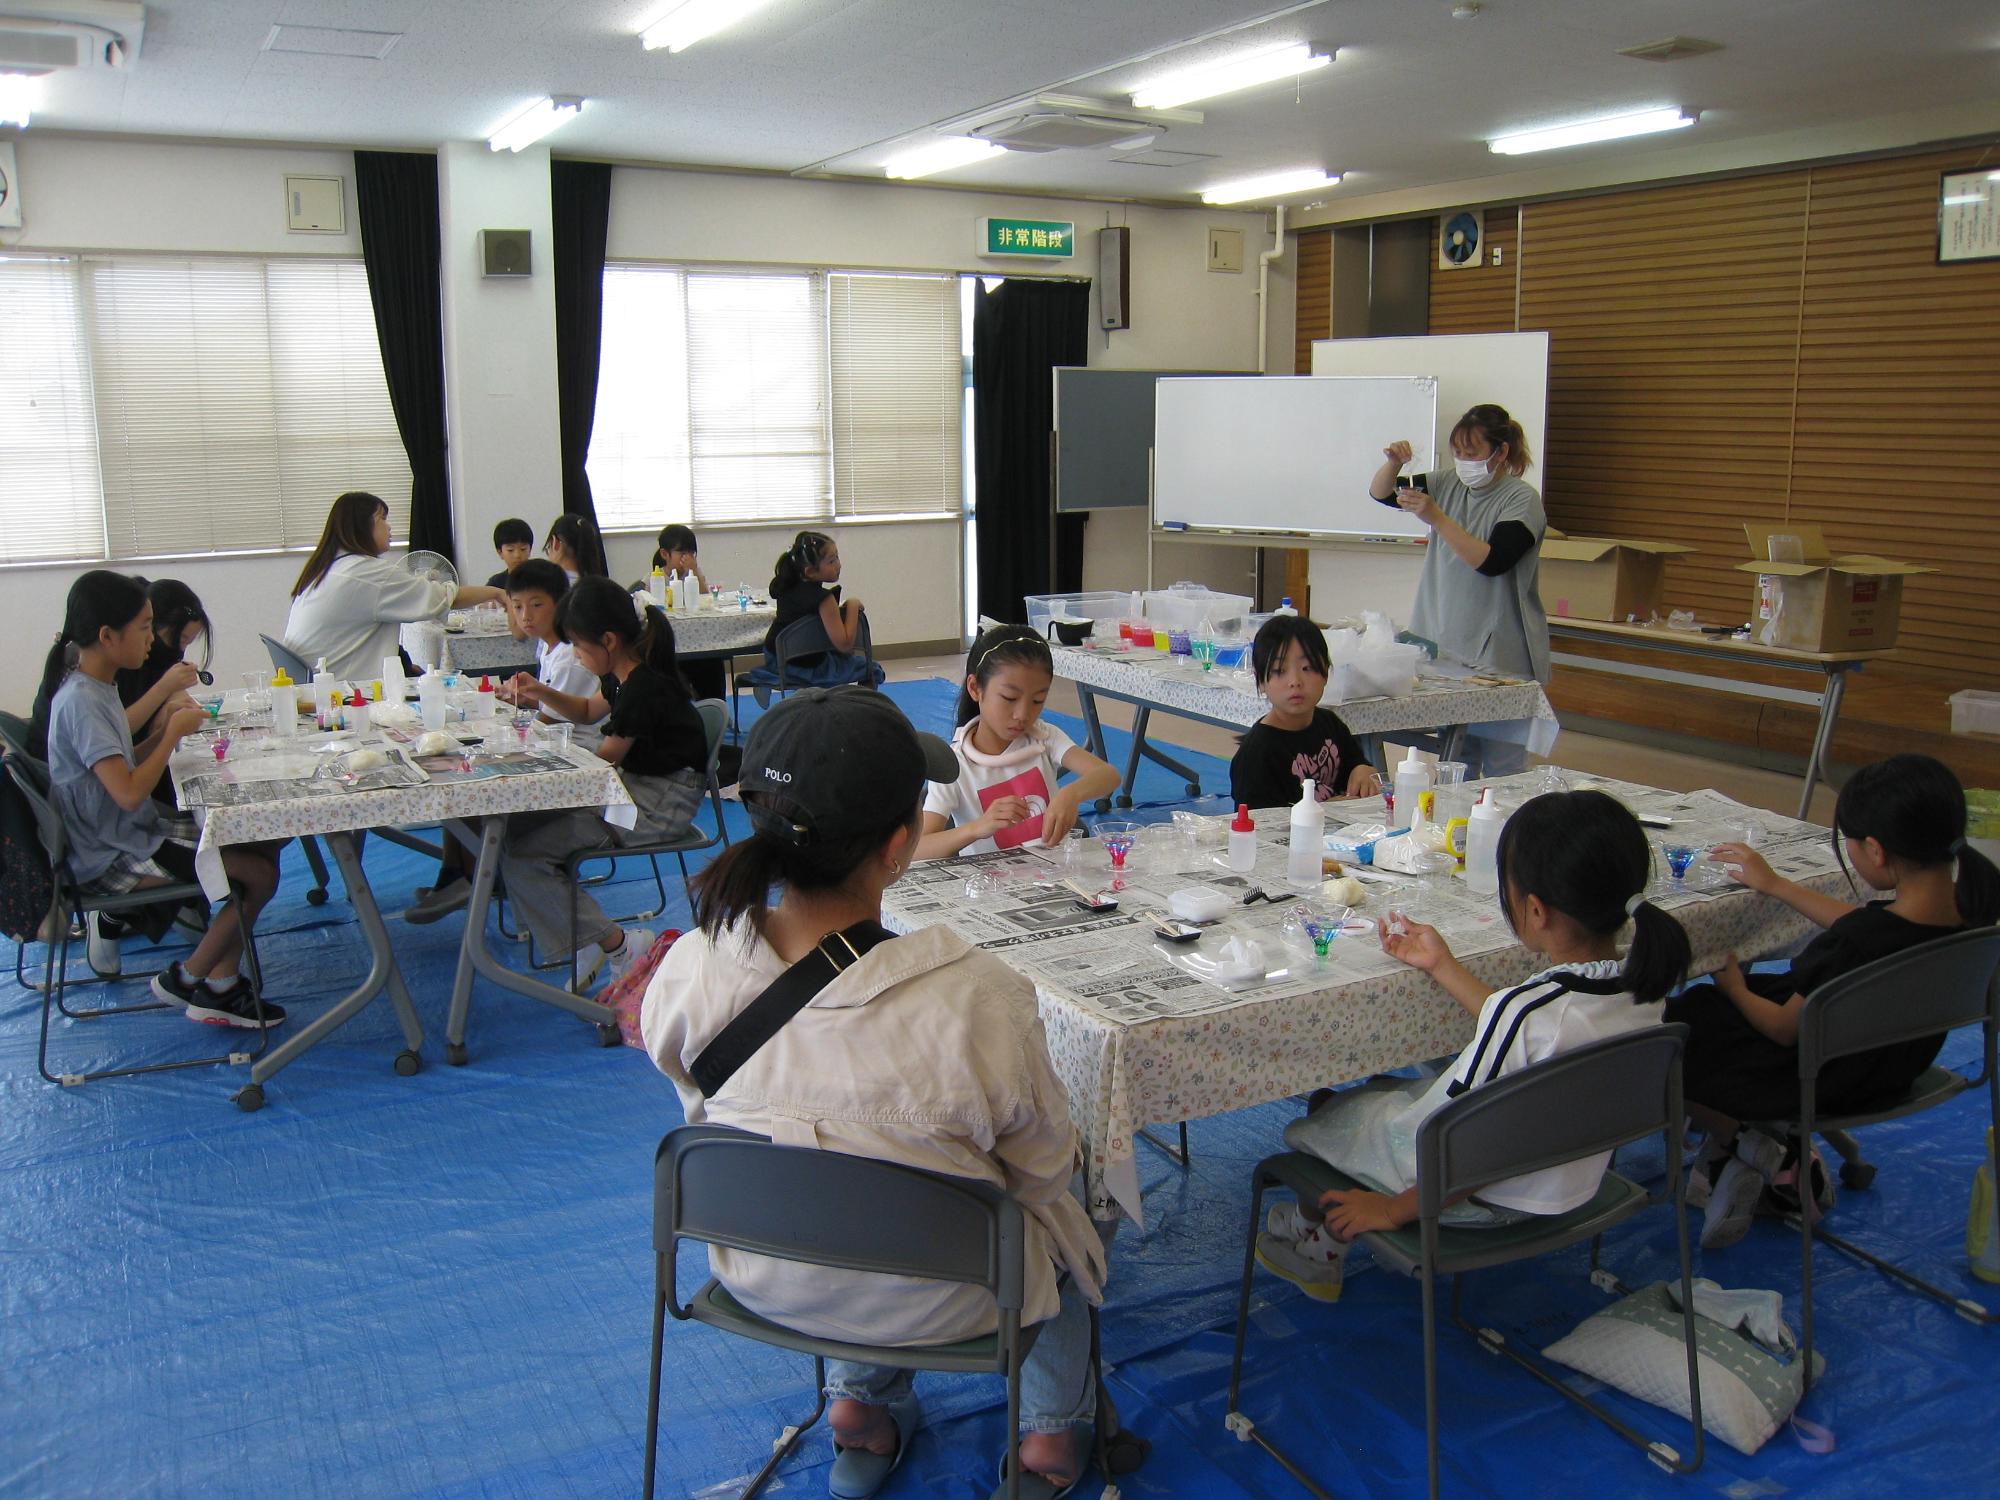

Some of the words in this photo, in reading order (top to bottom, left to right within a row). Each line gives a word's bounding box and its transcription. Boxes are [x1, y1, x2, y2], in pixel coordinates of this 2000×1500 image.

[998, 227, 1063, 248] 非常階段
[765, 767, 792, 783] POLO
